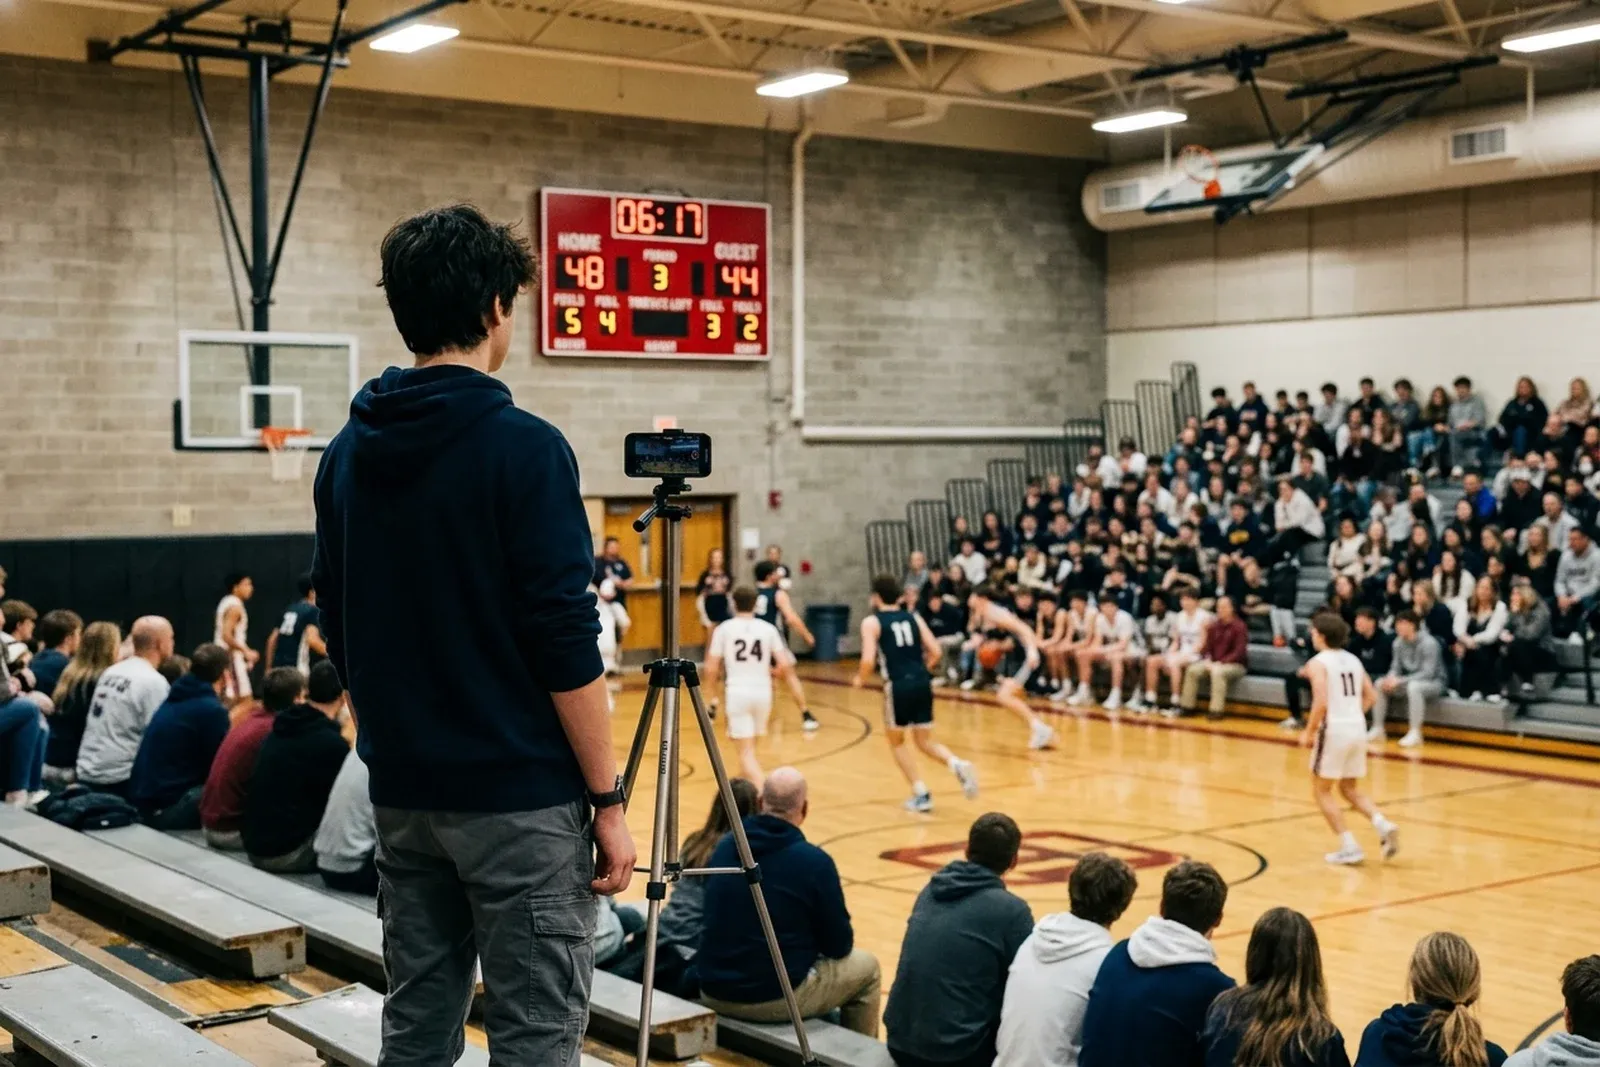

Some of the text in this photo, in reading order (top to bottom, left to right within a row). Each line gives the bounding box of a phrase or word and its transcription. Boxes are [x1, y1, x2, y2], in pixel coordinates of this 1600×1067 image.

[617, 199, 702, 236] 06:17
[565, 255, 604, 290] 48
[653, 264, 669, 291] 3
[721, 266, 759, 296] 44
[564, 307, 582, 335] 5
[599, 310, 616, 335] 4
[706, 313, 721, 339] 3
[743, 314, 759, 341] 2
[890, 620, 915, 647] 11
[734, 639, 763, 661] 24
[1340, 672, 1356, 697] 11
